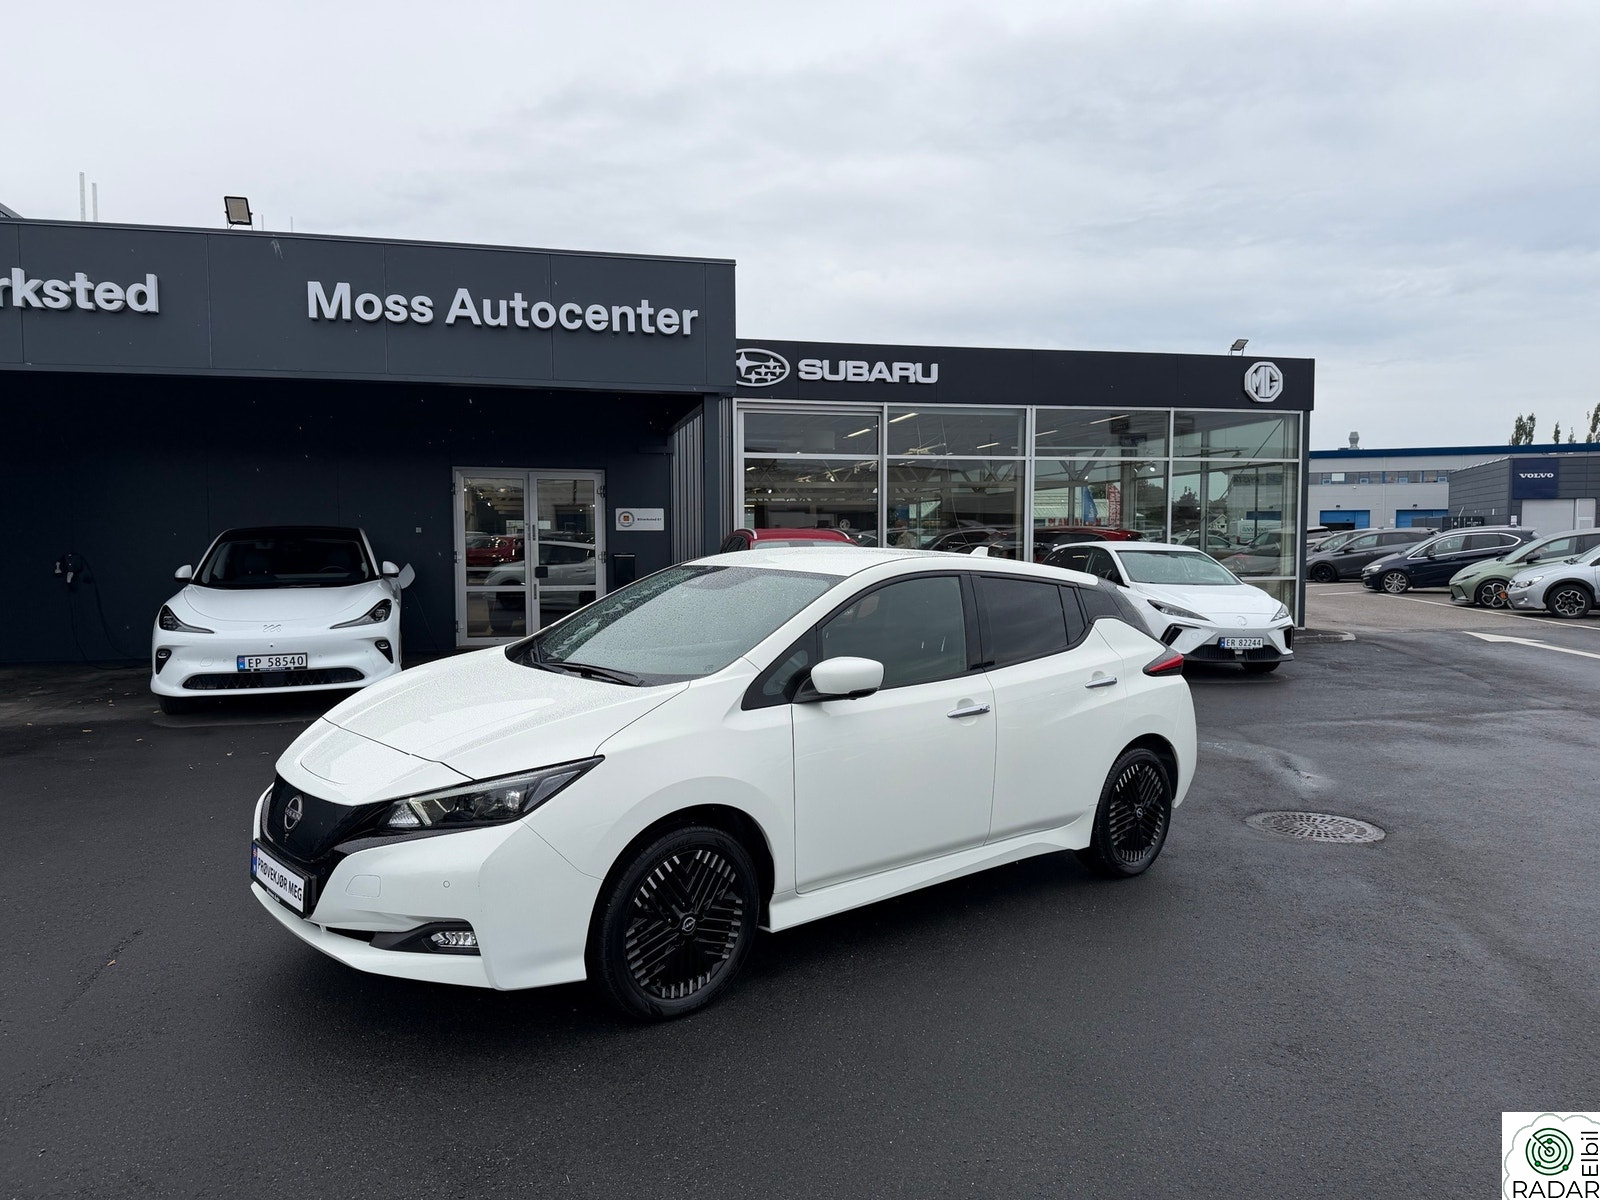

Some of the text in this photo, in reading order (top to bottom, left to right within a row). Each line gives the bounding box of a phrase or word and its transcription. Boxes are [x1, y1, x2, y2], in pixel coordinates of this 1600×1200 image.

[307, 281, 699, 335] Moss Autocenter
[798, 359, 939, 384] SUBARU
[1250, 365, 1280, 399] MG
[1226, 639, 1261, 647] ER 82244
[248, 655, 304, 668] EP 58540
[257, 857, 288, 893] PRØVEKJØR
[288, 882, 302, 901] MEG
